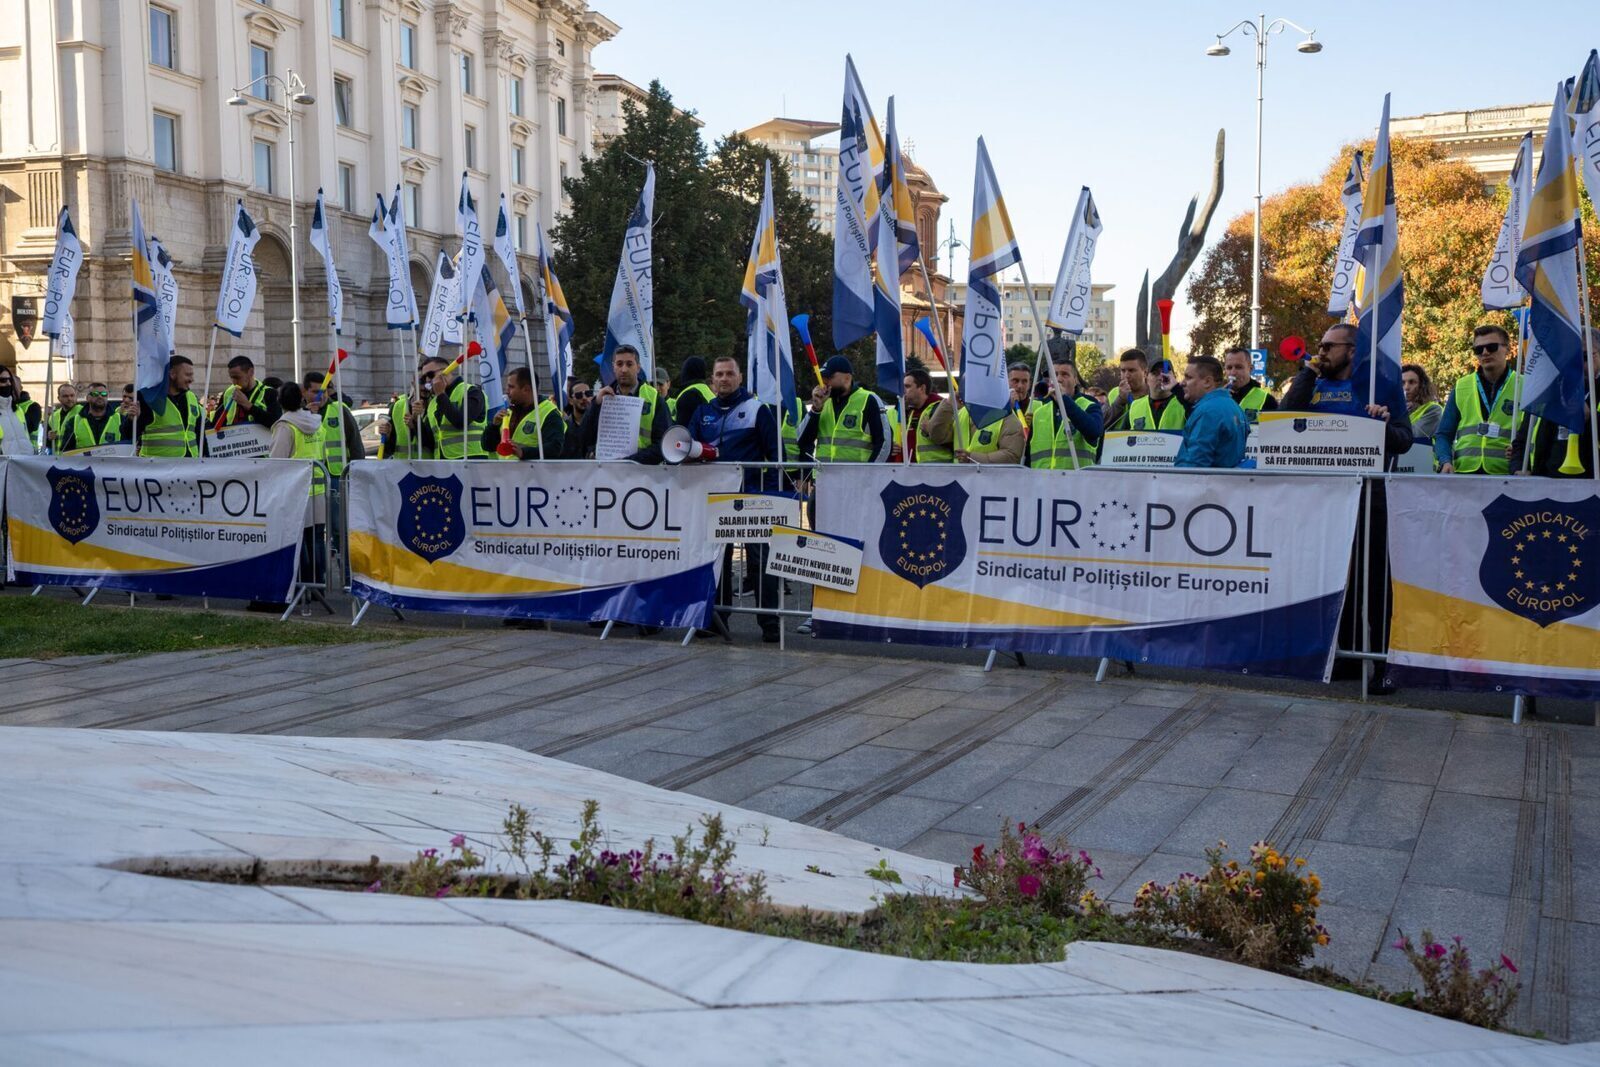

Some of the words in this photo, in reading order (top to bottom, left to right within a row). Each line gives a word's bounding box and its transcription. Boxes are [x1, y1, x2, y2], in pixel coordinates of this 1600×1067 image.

[1308, 419, 1348, 427] EUROPOL
[1260, 445, 1280, 454] VREM
[1281, 445, 1291, 454] CA
[1293, 445, 1342, 455] SALARIZAREA
[1265, 456, 1275, 465] SĂ
[1276, 456, 1287, 465] FIE
[1288, 457, 1335, 466] PRIORITATEA
[55, 474, 89, 493] SINDICATUL
[102, 477, 267, 518] EUROPOL
[409, 484, 454, 504] SINDICATUL
[471, 486, 682, 531] EUROPOL
[892, 493, 953, 519] SINDICATUL
[59, 522, 90, 536] EUROPOL
[719, 516, 747, 526] SALARII
[749, 516, 759, 525] NU
[760, 516, 770, 525] NE
[980, 496, 1272, 559] EUROPOL
[1501, 511, 1590, 542] SINDICATUL
[107, 524, 158, 538] Sindicatul
[161, 527, 215, 543] Polițiștilor
[218, 528, 267, 544] Europeni
[715, 529, 735, 538] DOAR
[736, 529, 745, 538] NE
[412, 536, 453, 553] EUROPOL
[475, 540, 540, 557] Sindicatul
[544, 542, 613, 562] Polițiștilor
[617, 543, 680, 561] Europeni
[770, 562, 782, 571] SAU
[797, 568, 823, 581] DRUMUL
[823, 572, 831, 582] LA
[810, 559, 831, 571] NEVOIE
[832, 564, 840, 573] DE
[841, 566, 852, 576] NOI
[896, 558, 947, 577] EUROPOL
[977, 561, 1066, 582] Sindicatul
[1073, 567, 1171, 592] Polițiștilor
[1177, 573, 1270, 597] Europeni
[1507, 588, 1585, 612] EUROPOL
